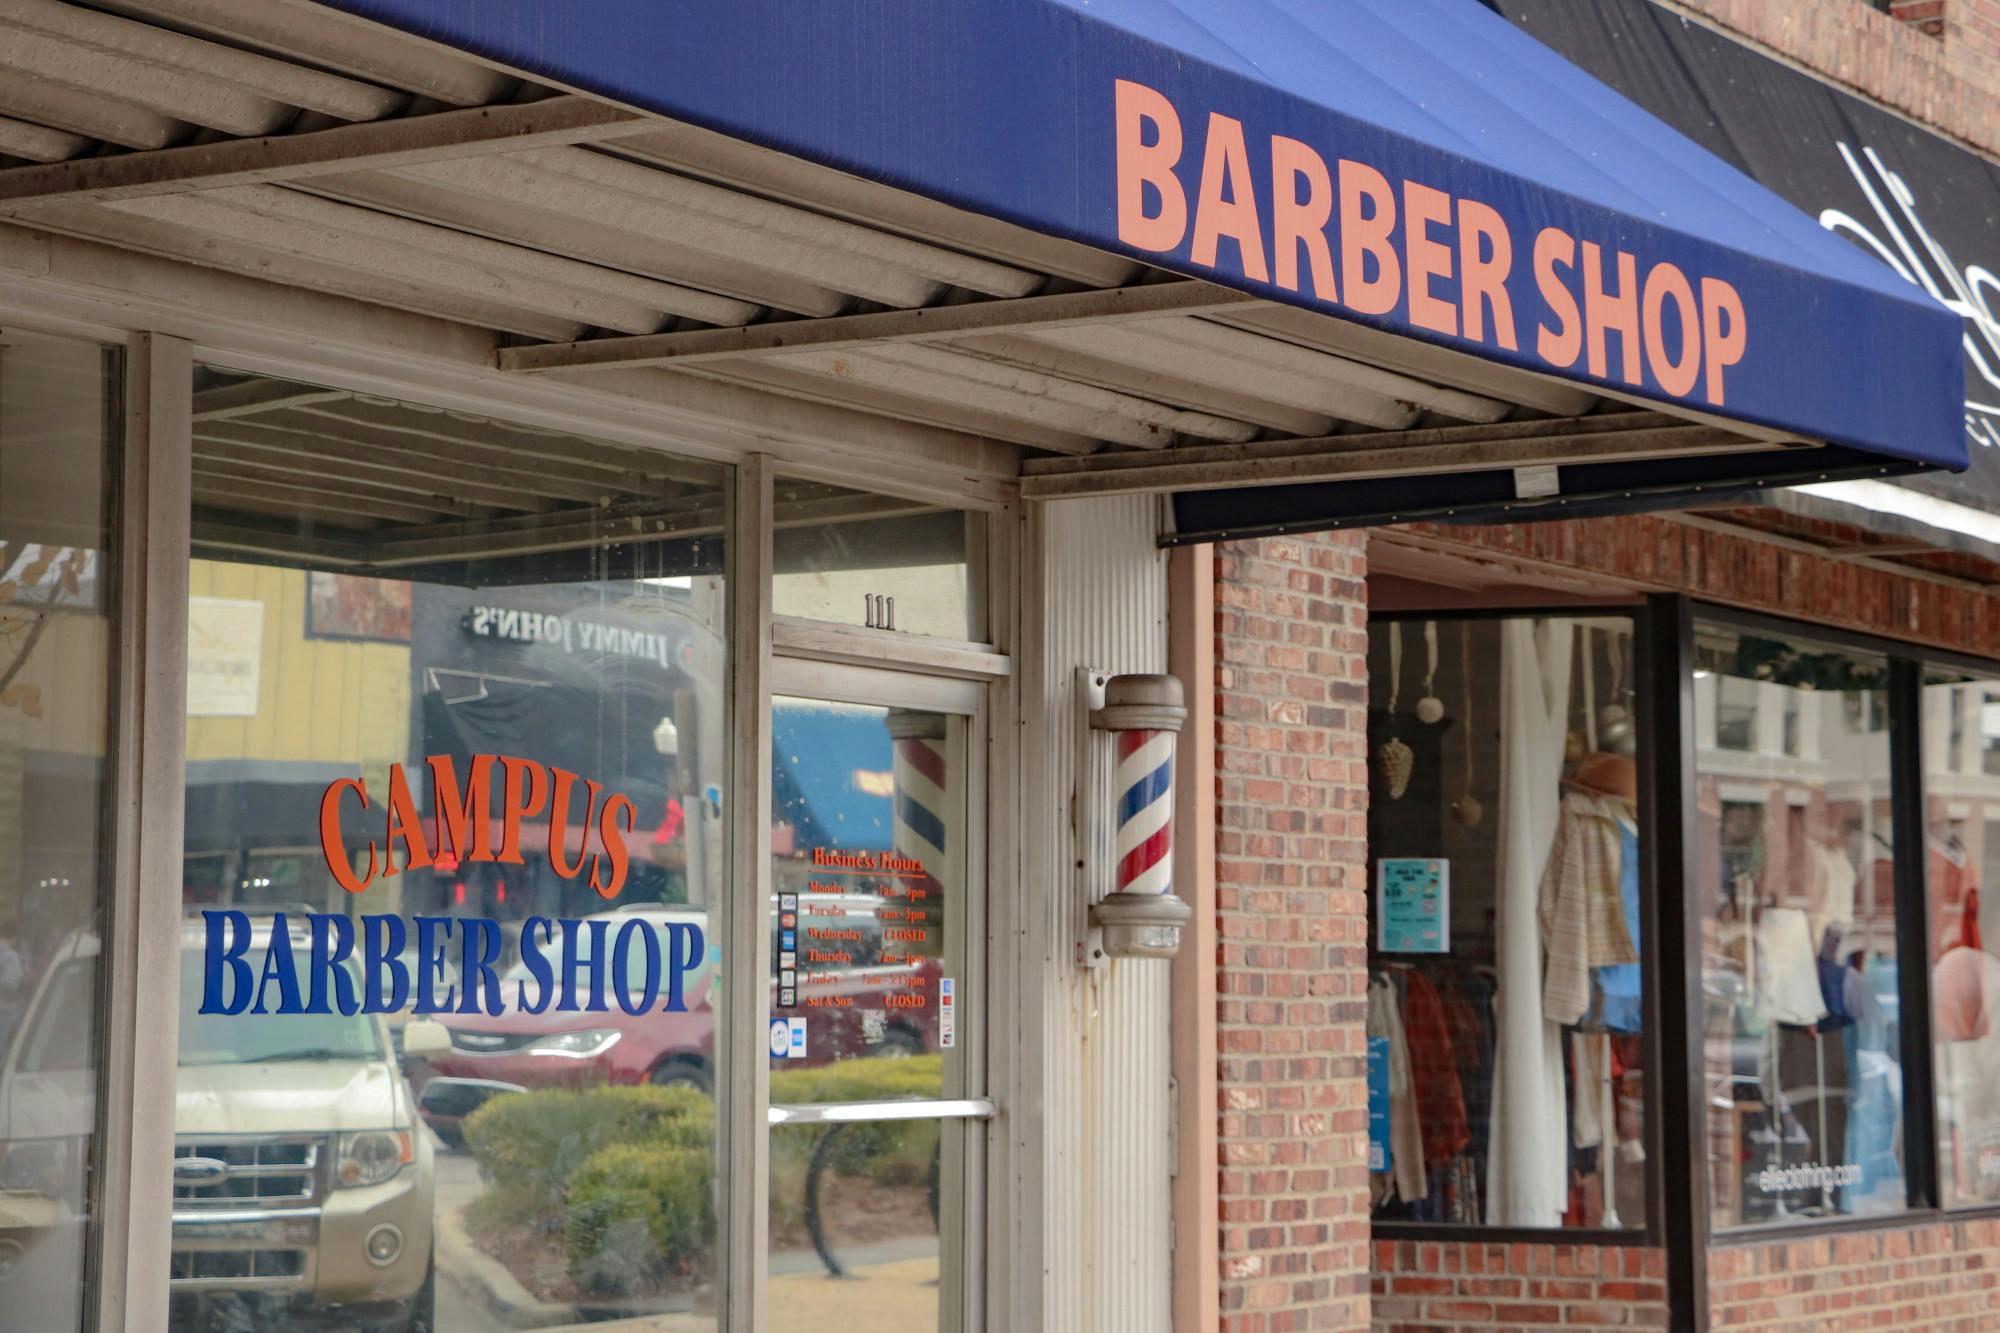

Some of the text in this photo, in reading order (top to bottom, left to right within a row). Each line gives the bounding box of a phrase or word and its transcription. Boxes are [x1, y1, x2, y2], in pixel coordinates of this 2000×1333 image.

[1115, 79, 1519, 353] BARBER
[1533, 227, 1748, 407] SHOP
[865, 593, 896, 631] 111
[320, 754, 638, 900] CAMPUS
[813, 847, 924, 872] Business Hours
[808, 881, 847, 898] Monday
[808, 927, 862, 943] Wednesday
[884, 928, 925, 942] CLOSED
[199, 910, 704, 1017] BARBER SHOP
[808, 948, 852, 964] Thursday
[834, 996, 853, 1008] Sun
[884, 995, 925, 1008] CLOSED
